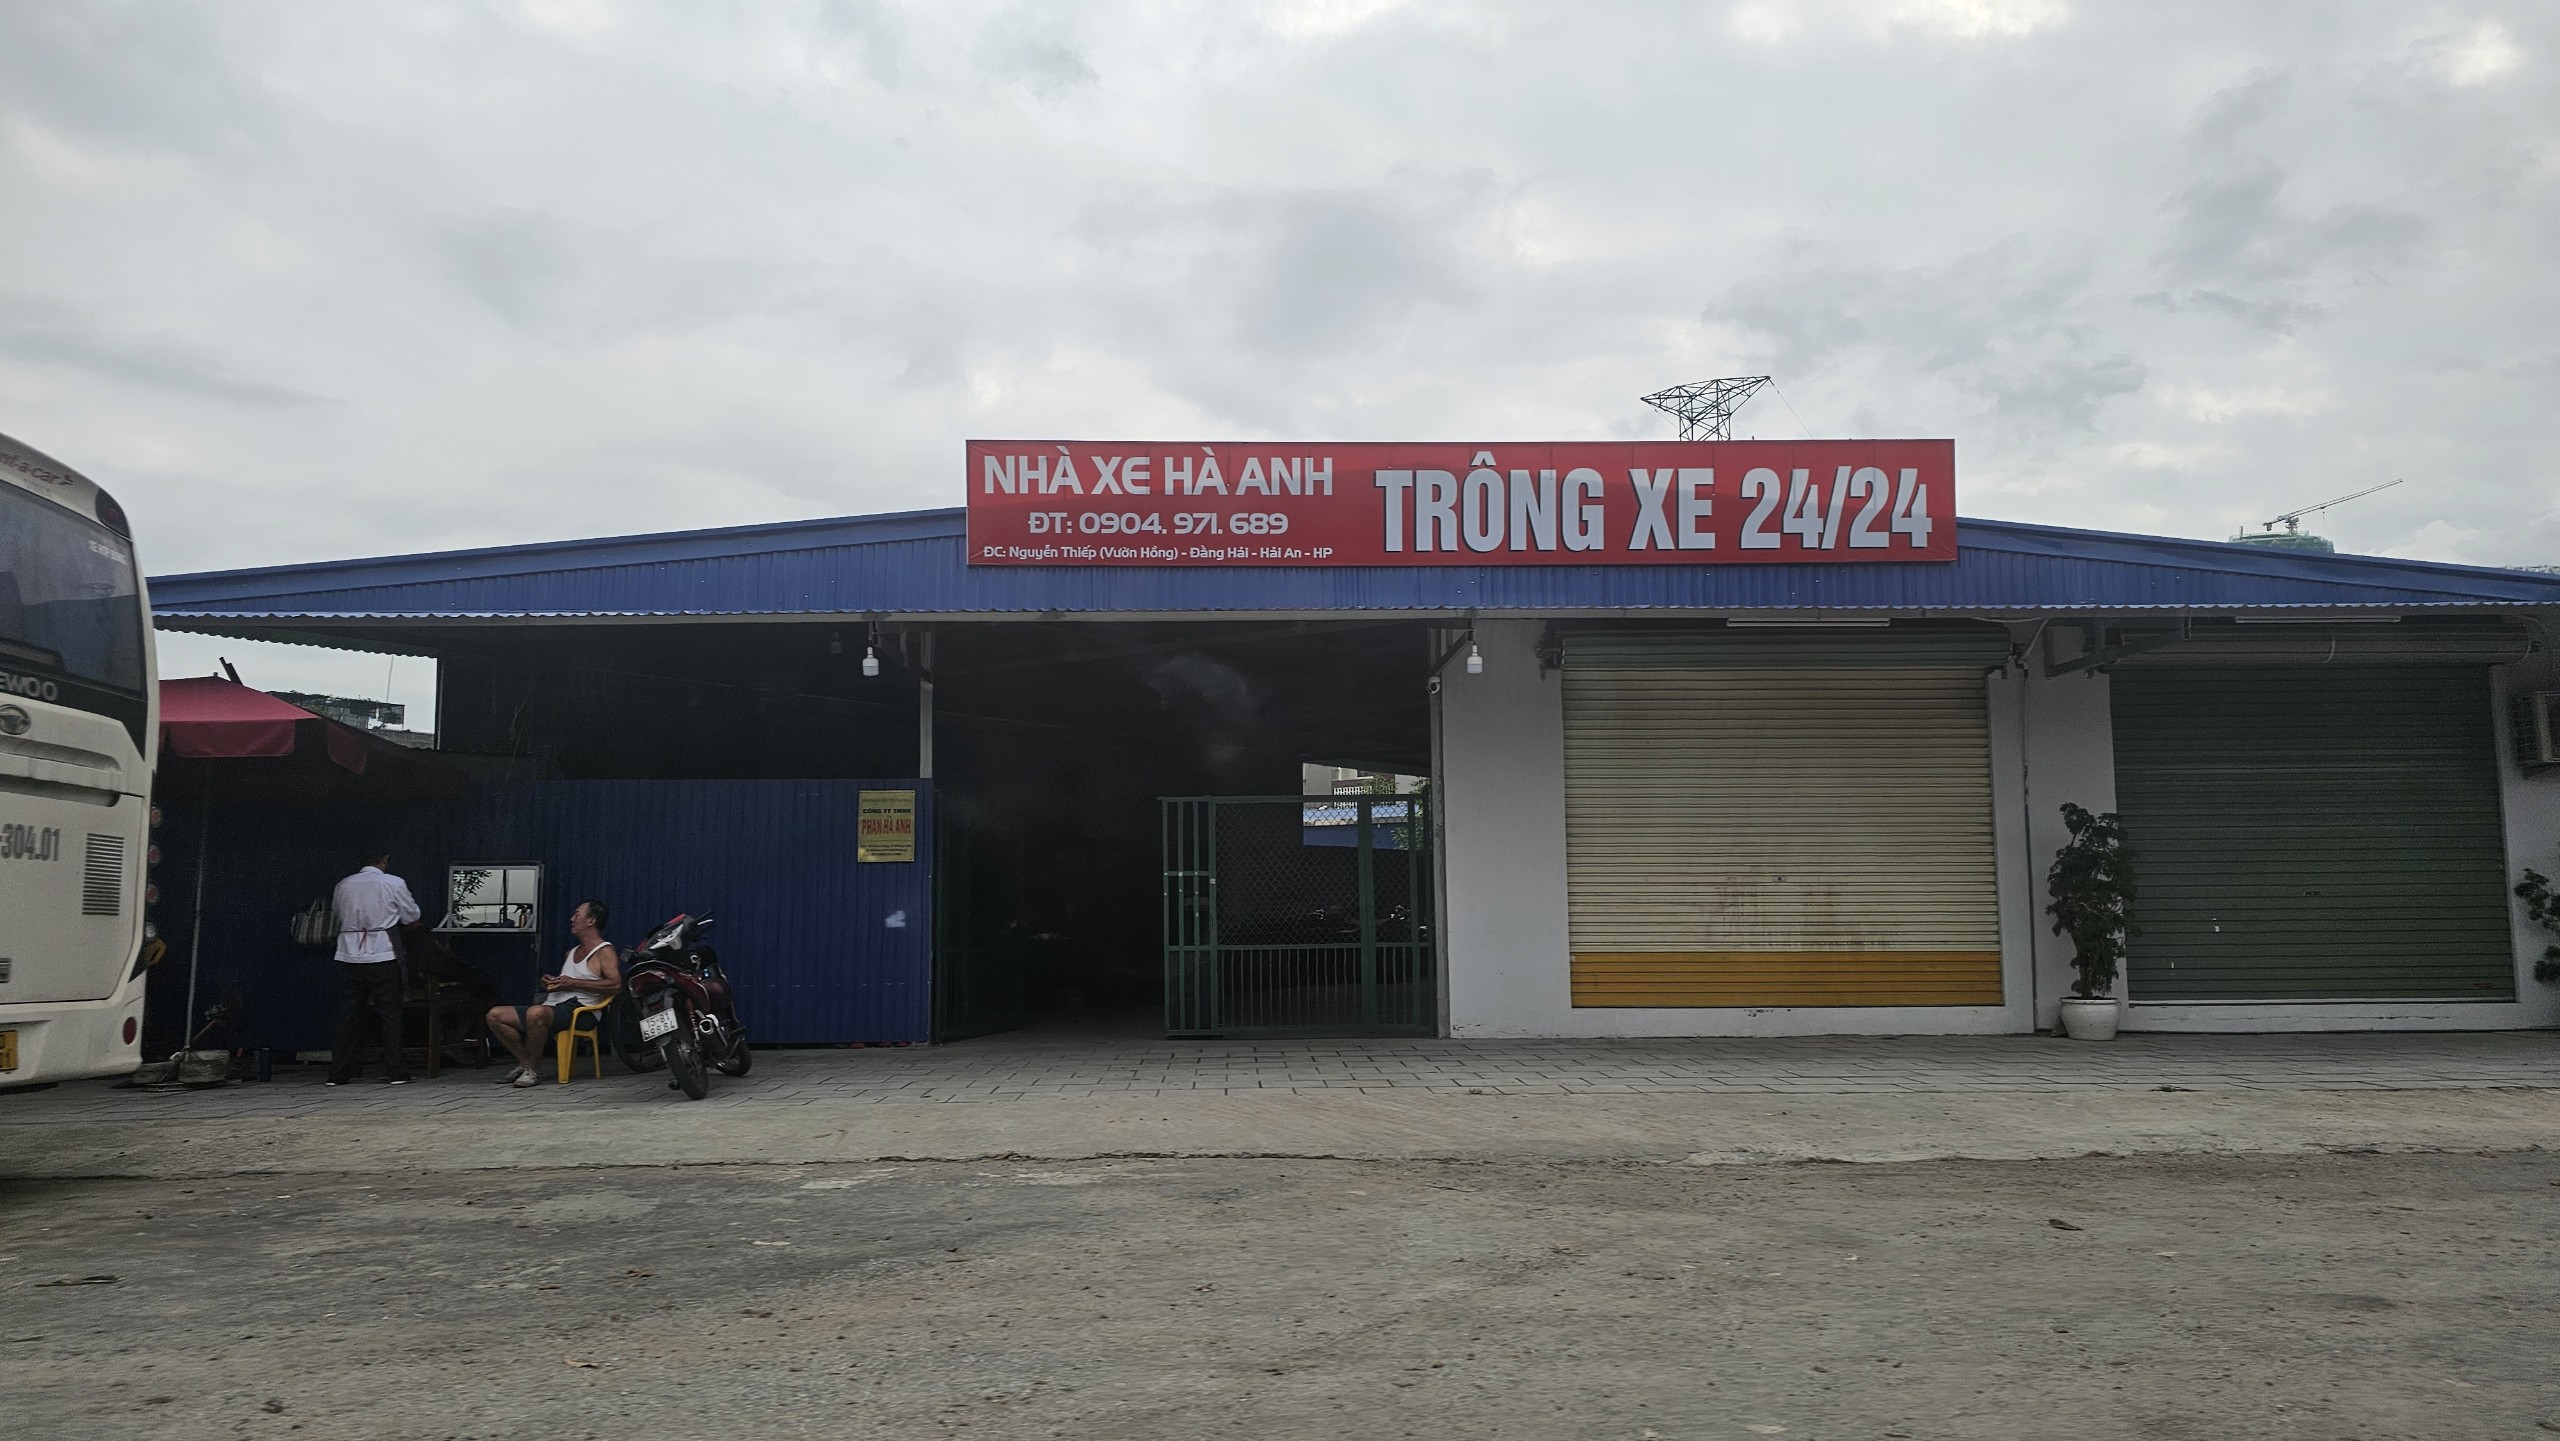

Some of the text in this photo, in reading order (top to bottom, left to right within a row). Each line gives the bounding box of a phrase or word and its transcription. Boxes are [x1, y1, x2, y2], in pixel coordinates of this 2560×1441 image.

[984, 445, 1333, 496] NHÀ XE HÀ ANH
[1374, 450, 1932, 553] TRÔNG XE 24/24
[1028, 512, 1289, 535] ĐT: 0904. 971. 689
[983, 545, 1006, 558] ĐC:
[1009, 545, 1058, 560] Nguyễn
[1061, 545, 1097, 561] Thiếp
[1099, 546, 1137, 560] (Vườn
[1140, 545, 1178, 561] Hồng)
[1227, 546, 1249, 559] Hải
[1260, 546, 1281, 559] Hải
[1284, 547, 1302, 559] An
[1312, 548, 1333, 559] HP
